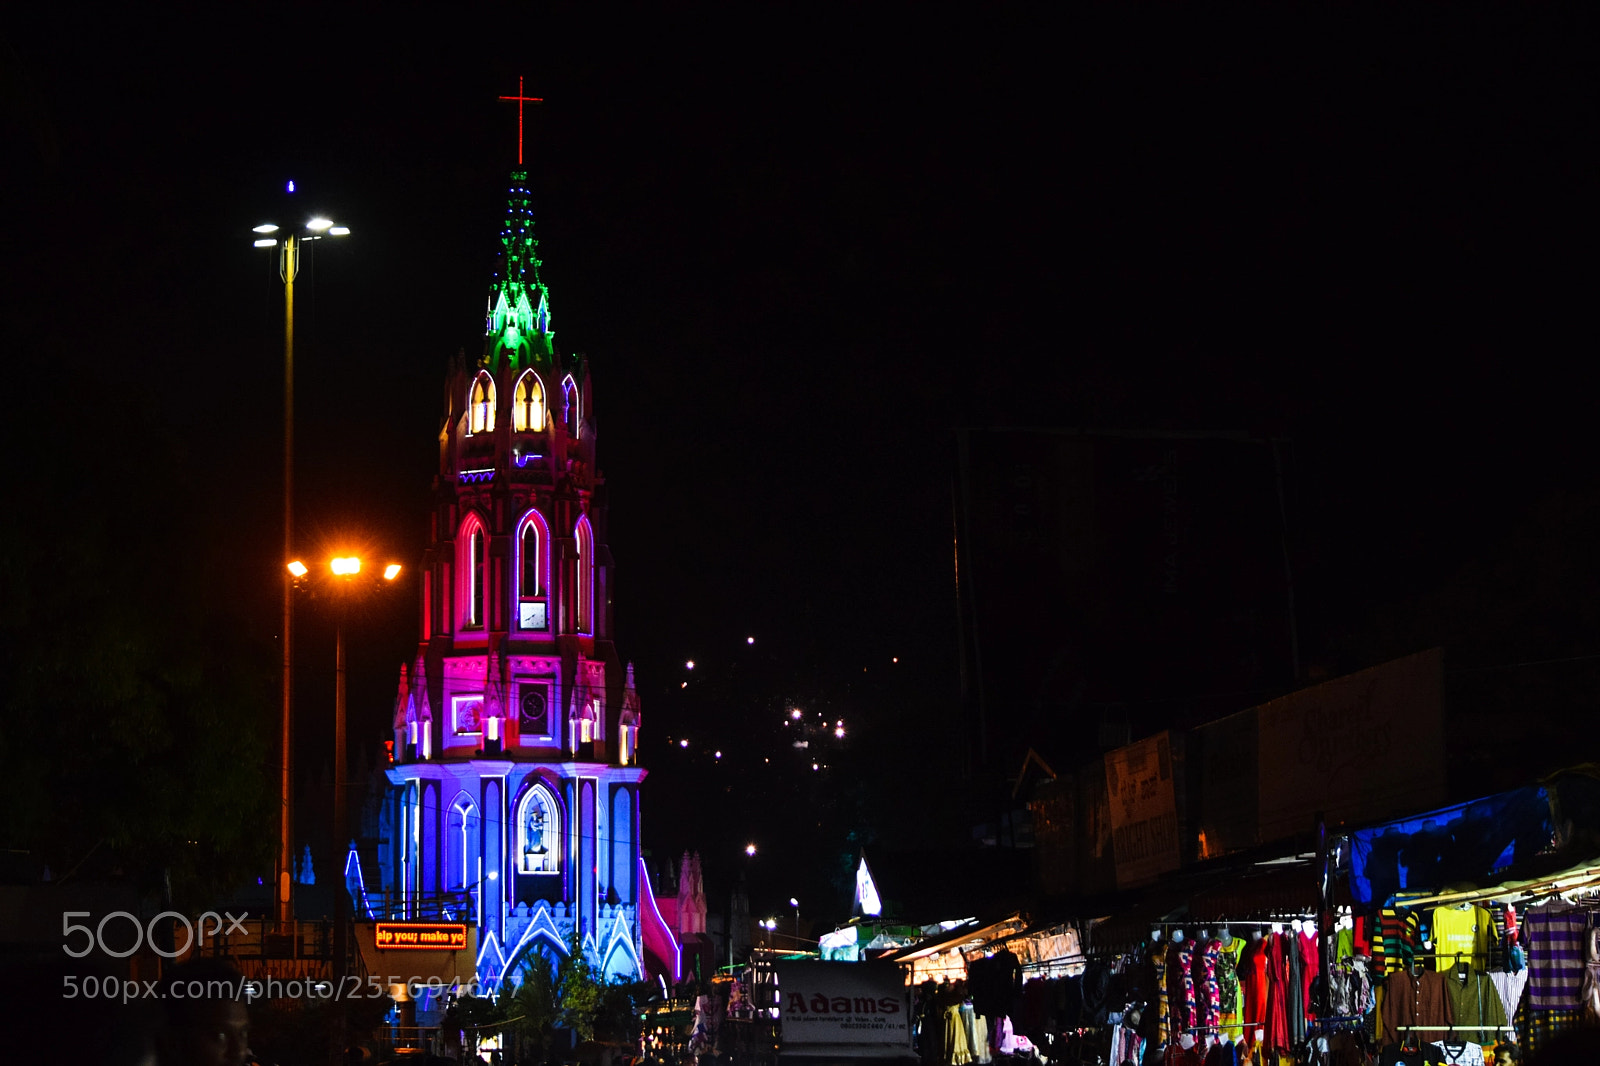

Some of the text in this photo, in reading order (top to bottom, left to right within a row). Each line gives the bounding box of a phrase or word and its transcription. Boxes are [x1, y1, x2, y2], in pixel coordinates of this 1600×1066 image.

[420, 931, 449, 943] make
[450, 933, 464, 945] yo
[785, 992, 900, 1014] Adams
